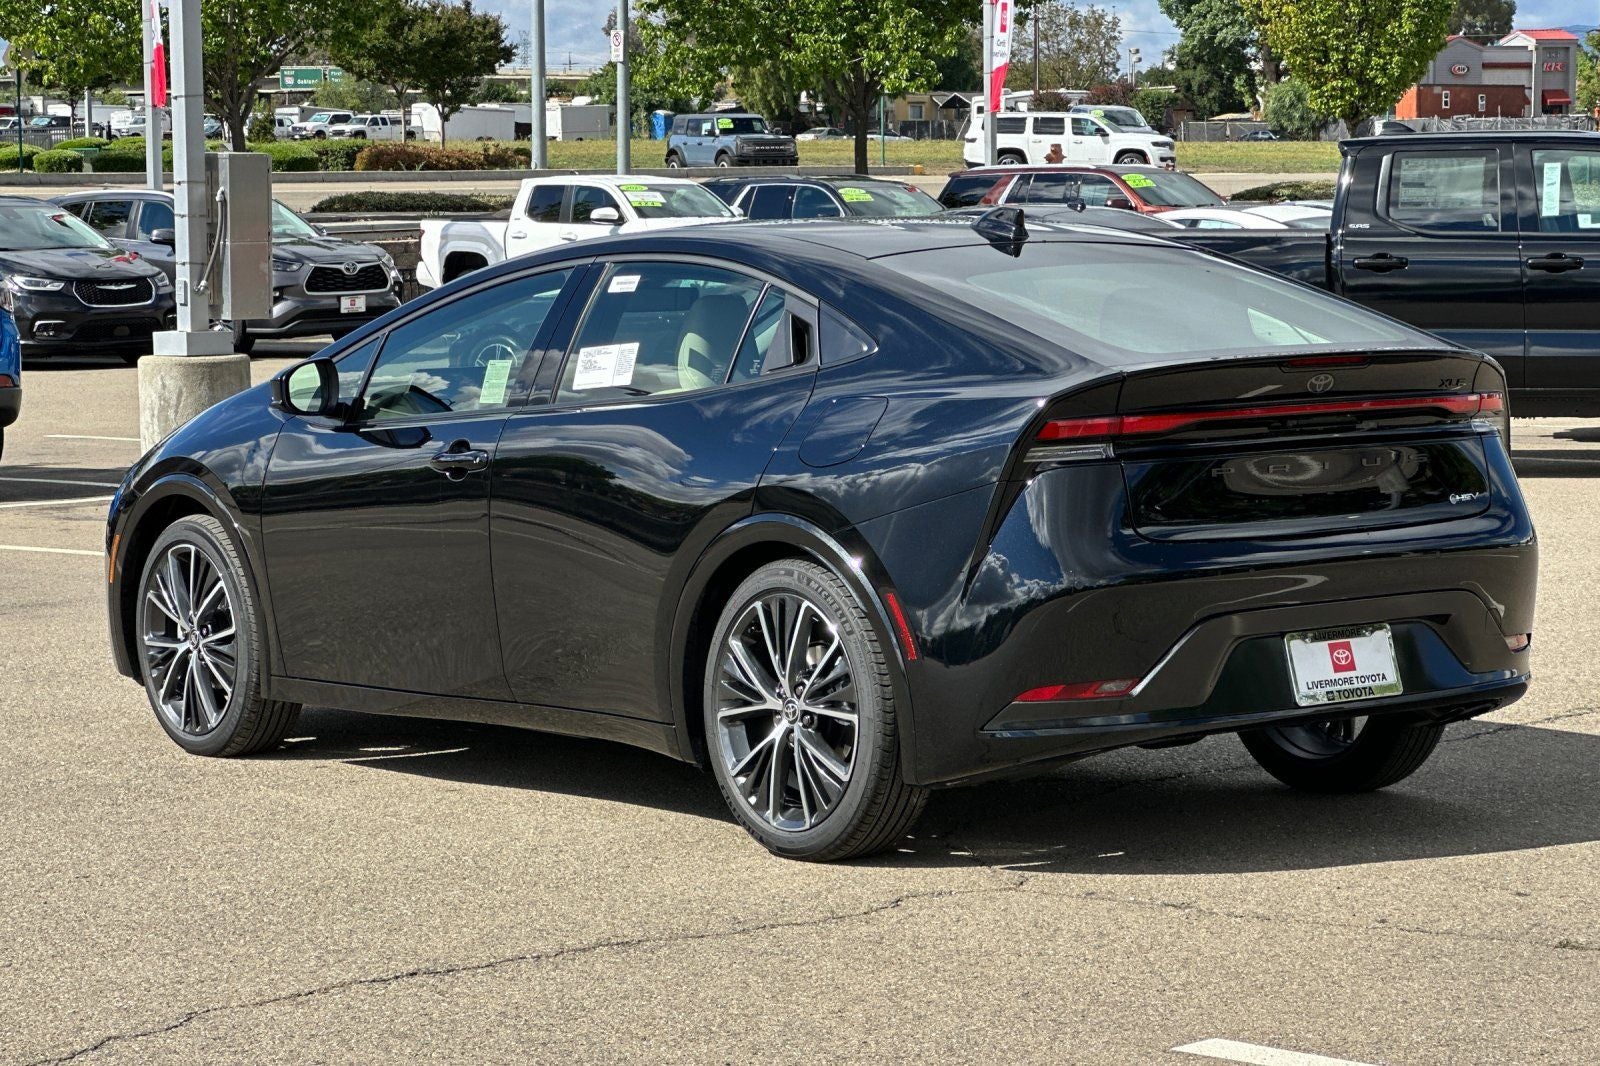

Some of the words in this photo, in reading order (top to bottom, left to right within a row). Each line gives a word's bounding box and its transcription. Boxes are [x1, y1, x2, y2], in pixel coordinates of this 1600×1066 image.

[1438, 378, 1467, 388] XLE
[1211, 453, 1429, 478] PRIUS
[809, 580, 855, 636] MICHELIN
[1314, 628, 1361, 641] LIVERMORE
[1306, 676, 1354, 690] LIVERMORE
[1355, 672, 1387, 684] TOYOTA
[1336, 686, 1375, 700] TOYOTA
